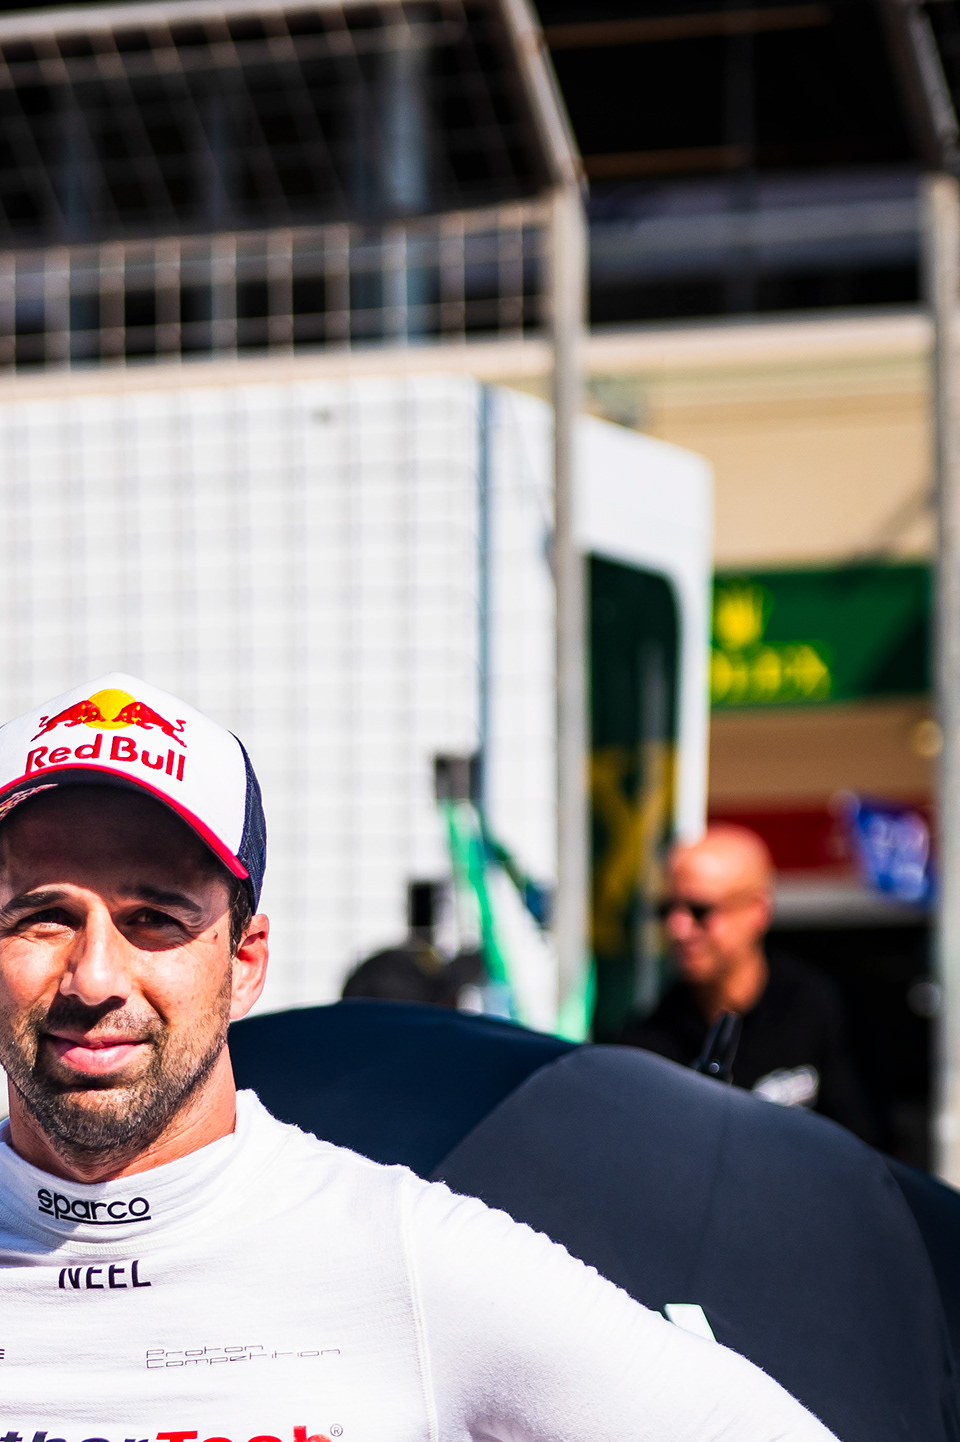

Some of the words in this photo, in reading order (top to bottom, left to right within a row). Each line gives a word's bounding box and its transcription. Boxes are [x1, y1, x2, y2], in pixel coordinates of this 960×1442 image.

[25, 733, 103, 774] Red
[110, 735, 186, 782] Bull
[37, 1188, 151, 1222] sparco
[58, 1260, 152, 1289] NEEL
[146, 1345, 263, 1359] Proton
[146, 1349, 341, 1369] Competition
